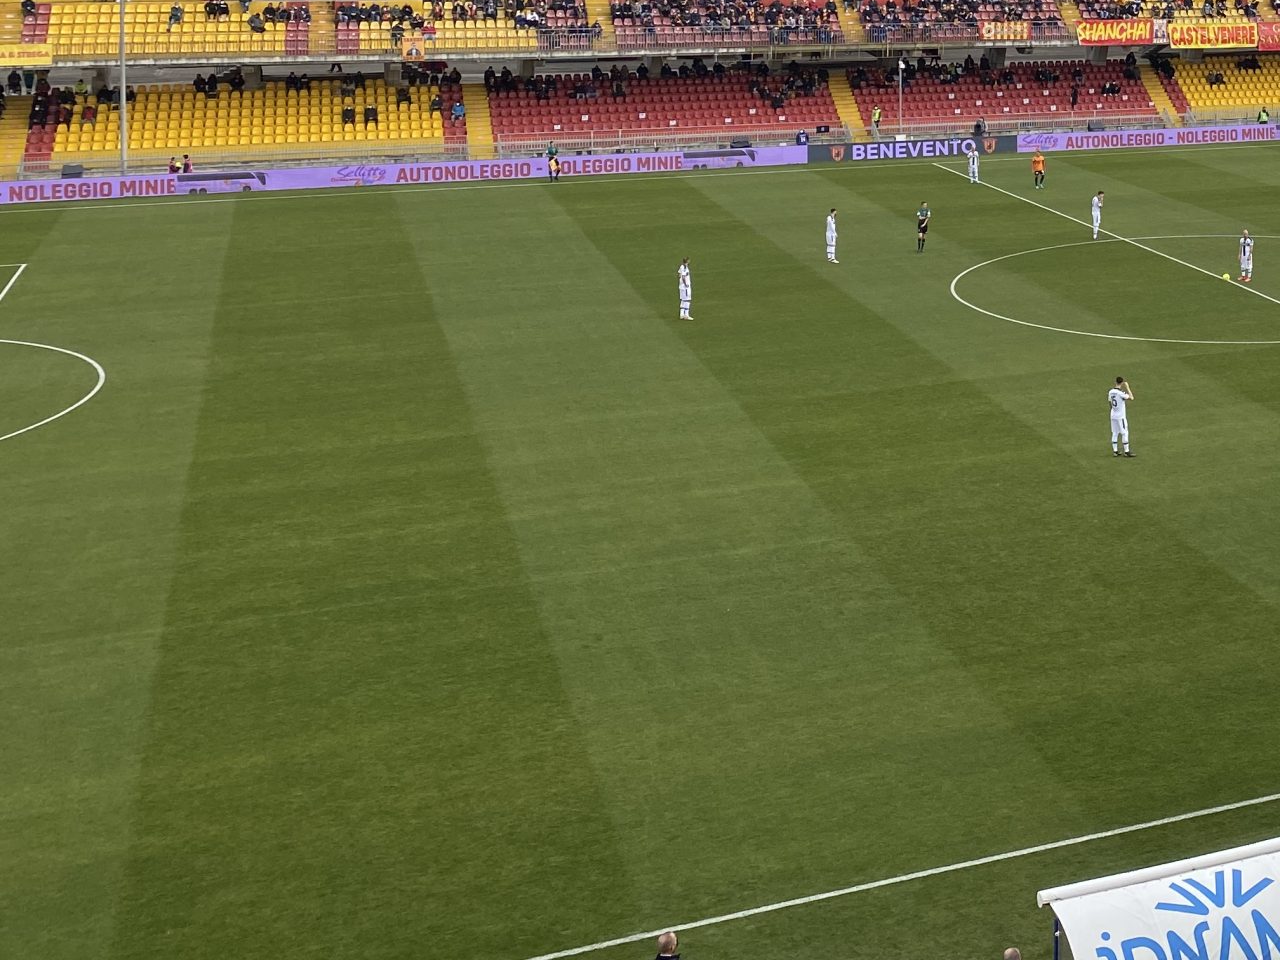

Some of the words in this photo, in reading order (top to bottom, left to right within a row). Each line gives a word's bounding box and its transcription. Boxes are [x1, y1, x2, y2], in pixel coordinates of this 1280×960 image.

[1078, 21, 1151, 41] SHANGHAI
[1065, 133, 1165, 149] AUTONOLEGGIO
[1177, 126, 1238, 144] NOLEGGIO
[852, 139, 976, 161] BENEVENTO
[396, 162, 531, 183] AUTONOLEGGIO
[551, 157, 631, 175] OLEGGIO
[9, 181, 112, 202] NOLEGGIO
